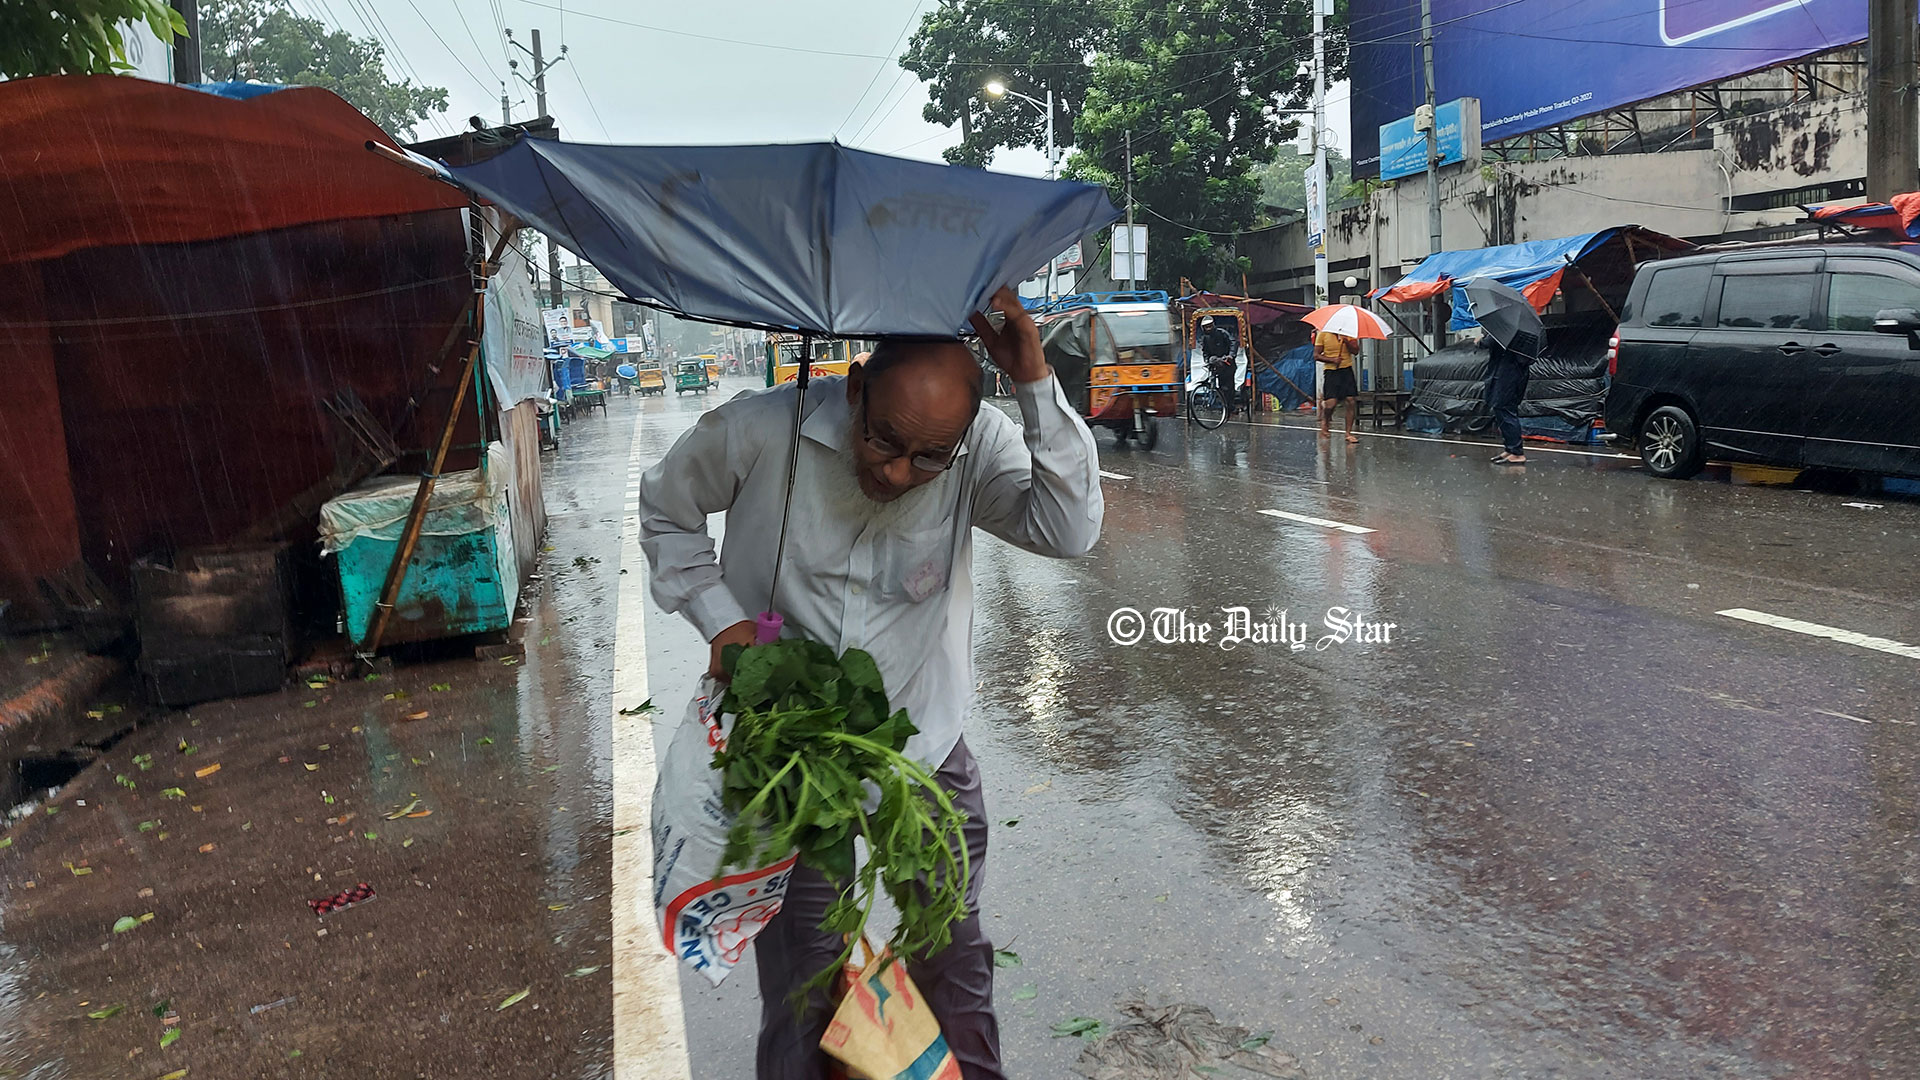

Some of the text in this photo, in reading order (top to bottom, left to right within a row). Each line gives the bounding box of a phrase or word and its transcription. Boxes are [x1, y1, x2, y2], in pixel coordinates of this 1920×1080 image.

[1503, 112, 1524, 125] Quarterly
[1523, 107, 1540, 118] Mobile
[1538, 103, 1554, 115] Phone
[1571, 92, 1593, 105] Q2-2022
